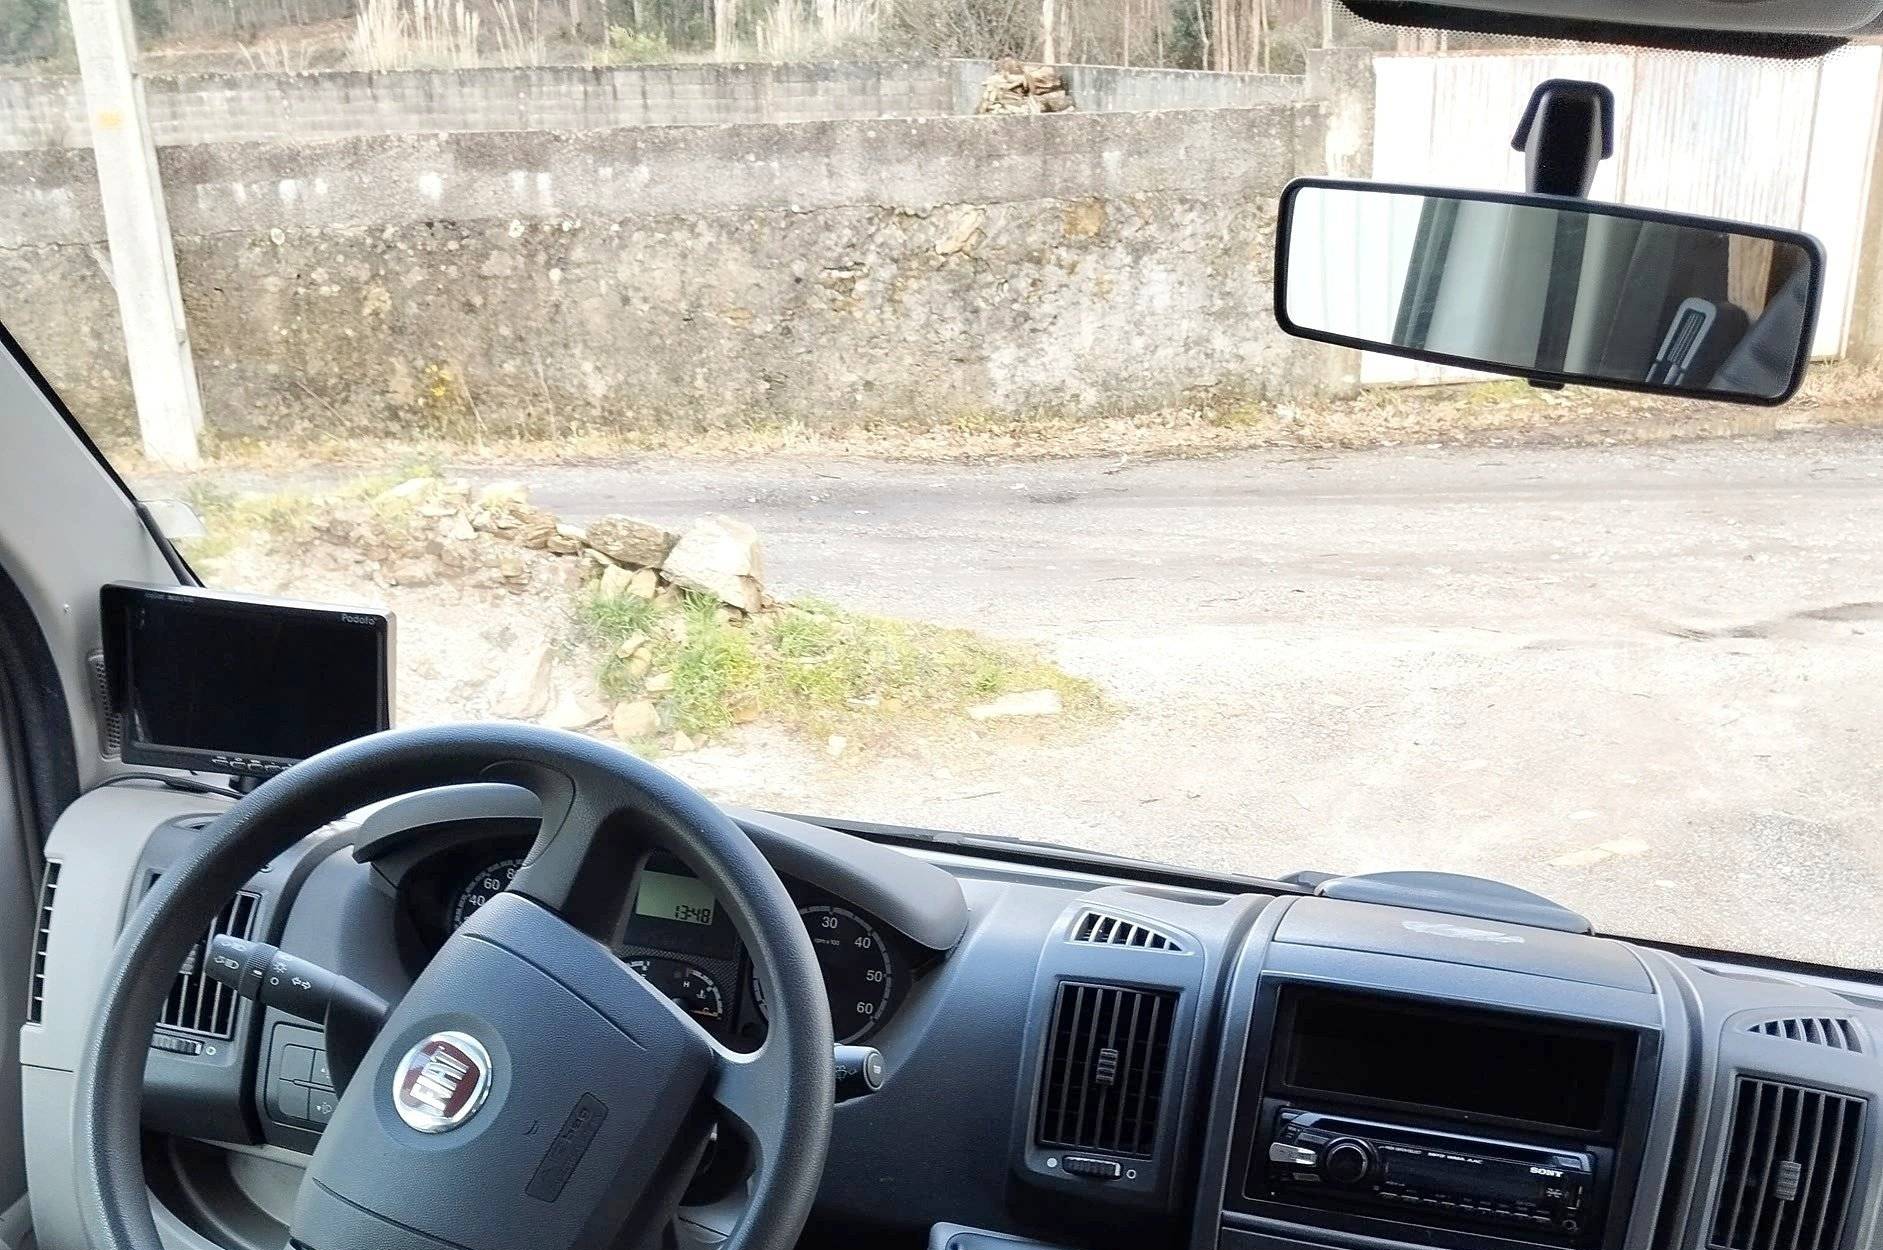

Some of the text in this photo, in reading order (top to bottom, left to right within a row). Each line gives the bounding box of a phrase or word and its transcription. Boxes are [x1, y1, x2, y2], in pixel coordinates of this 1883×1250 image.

[483, 878, 500, 890] 60
[468, 894, 486, 906] 40
[674, 904, 712, 924] 13:48
[821, 916, 838, 929] 30
[854, 937, 871, 949] 40
[866, 970, 883, 983] 50
[856, 1001, 873, 1015] 60
[409, 1045, 470, 1113] FIAT
[1529, 1166, 1565, 1178] SONY
